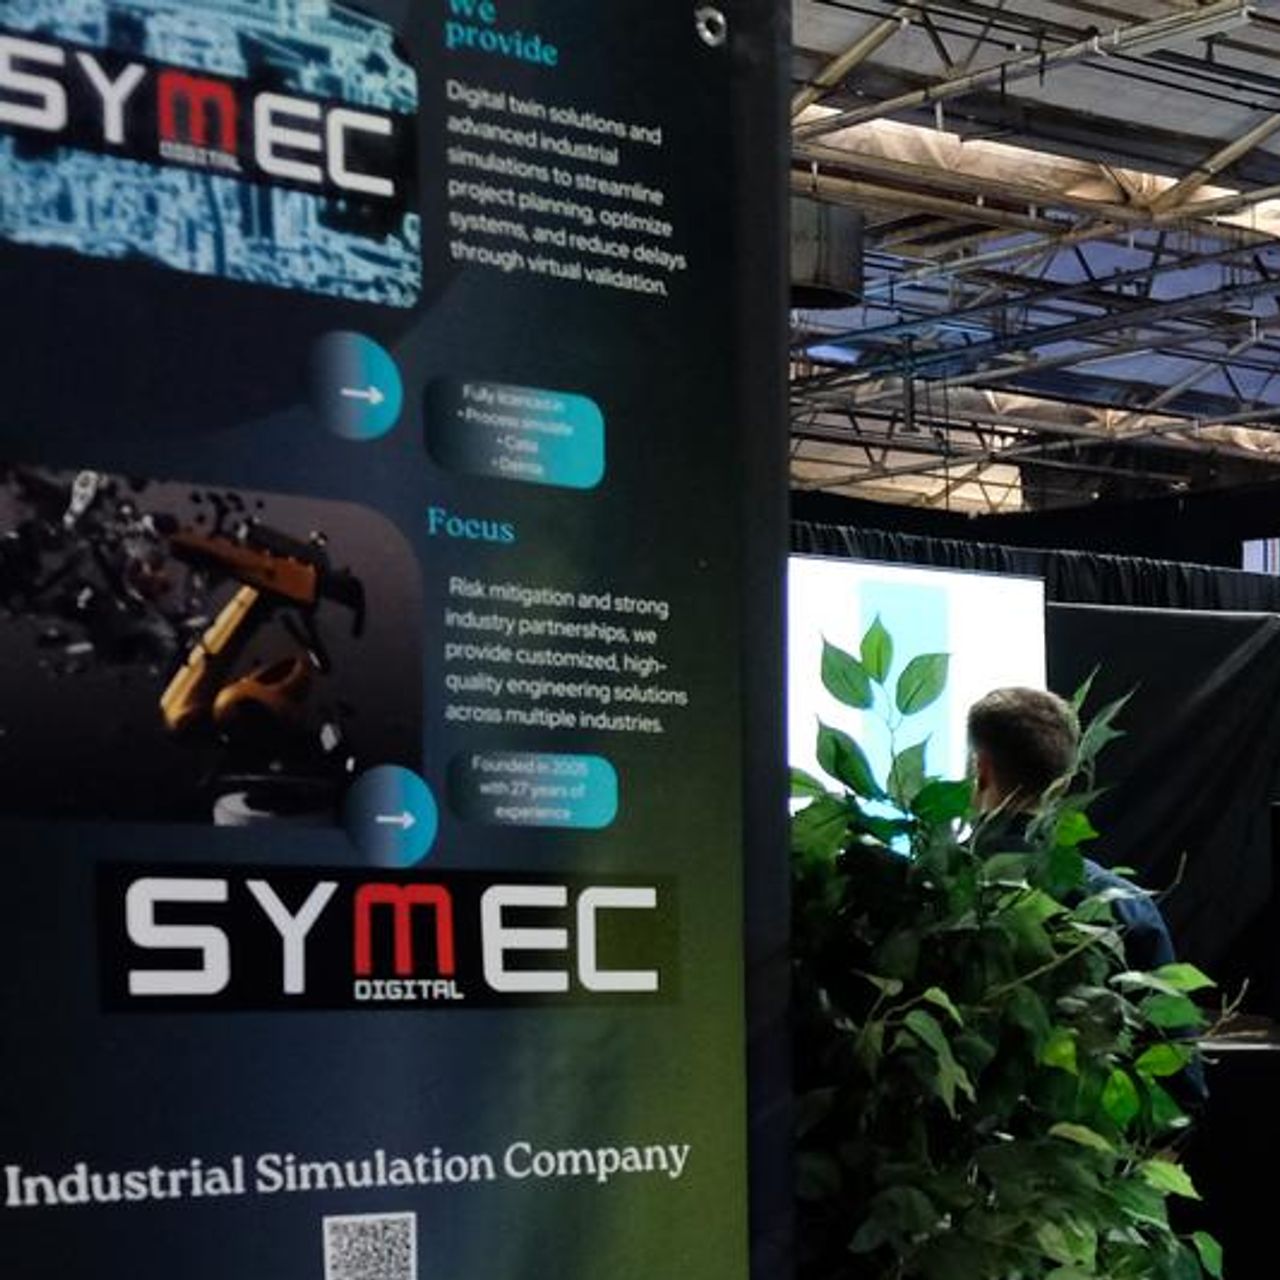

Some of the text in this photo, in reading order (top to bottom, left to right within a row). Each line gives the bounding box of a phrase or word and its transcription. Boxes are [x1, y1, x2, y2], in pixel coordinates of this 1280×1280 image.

[445, 21, 558, 66] provide
[0, 35, 395, 197] SYMEC
[447, 79, 662, 146] Digital twin solutions and
[447, 115, 618, 166] advanced industrial
[447, 147, 663, 206] simulations to streamline
[448, 178, 673, 237] project planning, optimize
[449, 211, 687, 272] systems, and reduce delays
[450, 240, 668, 296] through virtual validation.
[428, 507, 516, 544] Focus
[449, 576, 669, 620] Risk mitigation and strong
[445, 609, 657, 644] industry partnerships, we
[445, 641, 668, 678] provide customized, high-
[446, 672, 688, 706] quality engineering solutions
[445, 703, 664, 733] across multiple industries.
[472, 755, 534, 774] Founded
[480, 781, 509, 795] with
[531, 785, 568, 801] years
[570, 782, 586, 798] of
[125, 877, 659, 996] SYMEC
[354, 978, 465, 1001] DIGITAL
[4, 1141, 691, 1208] Industrial Simulation Company
